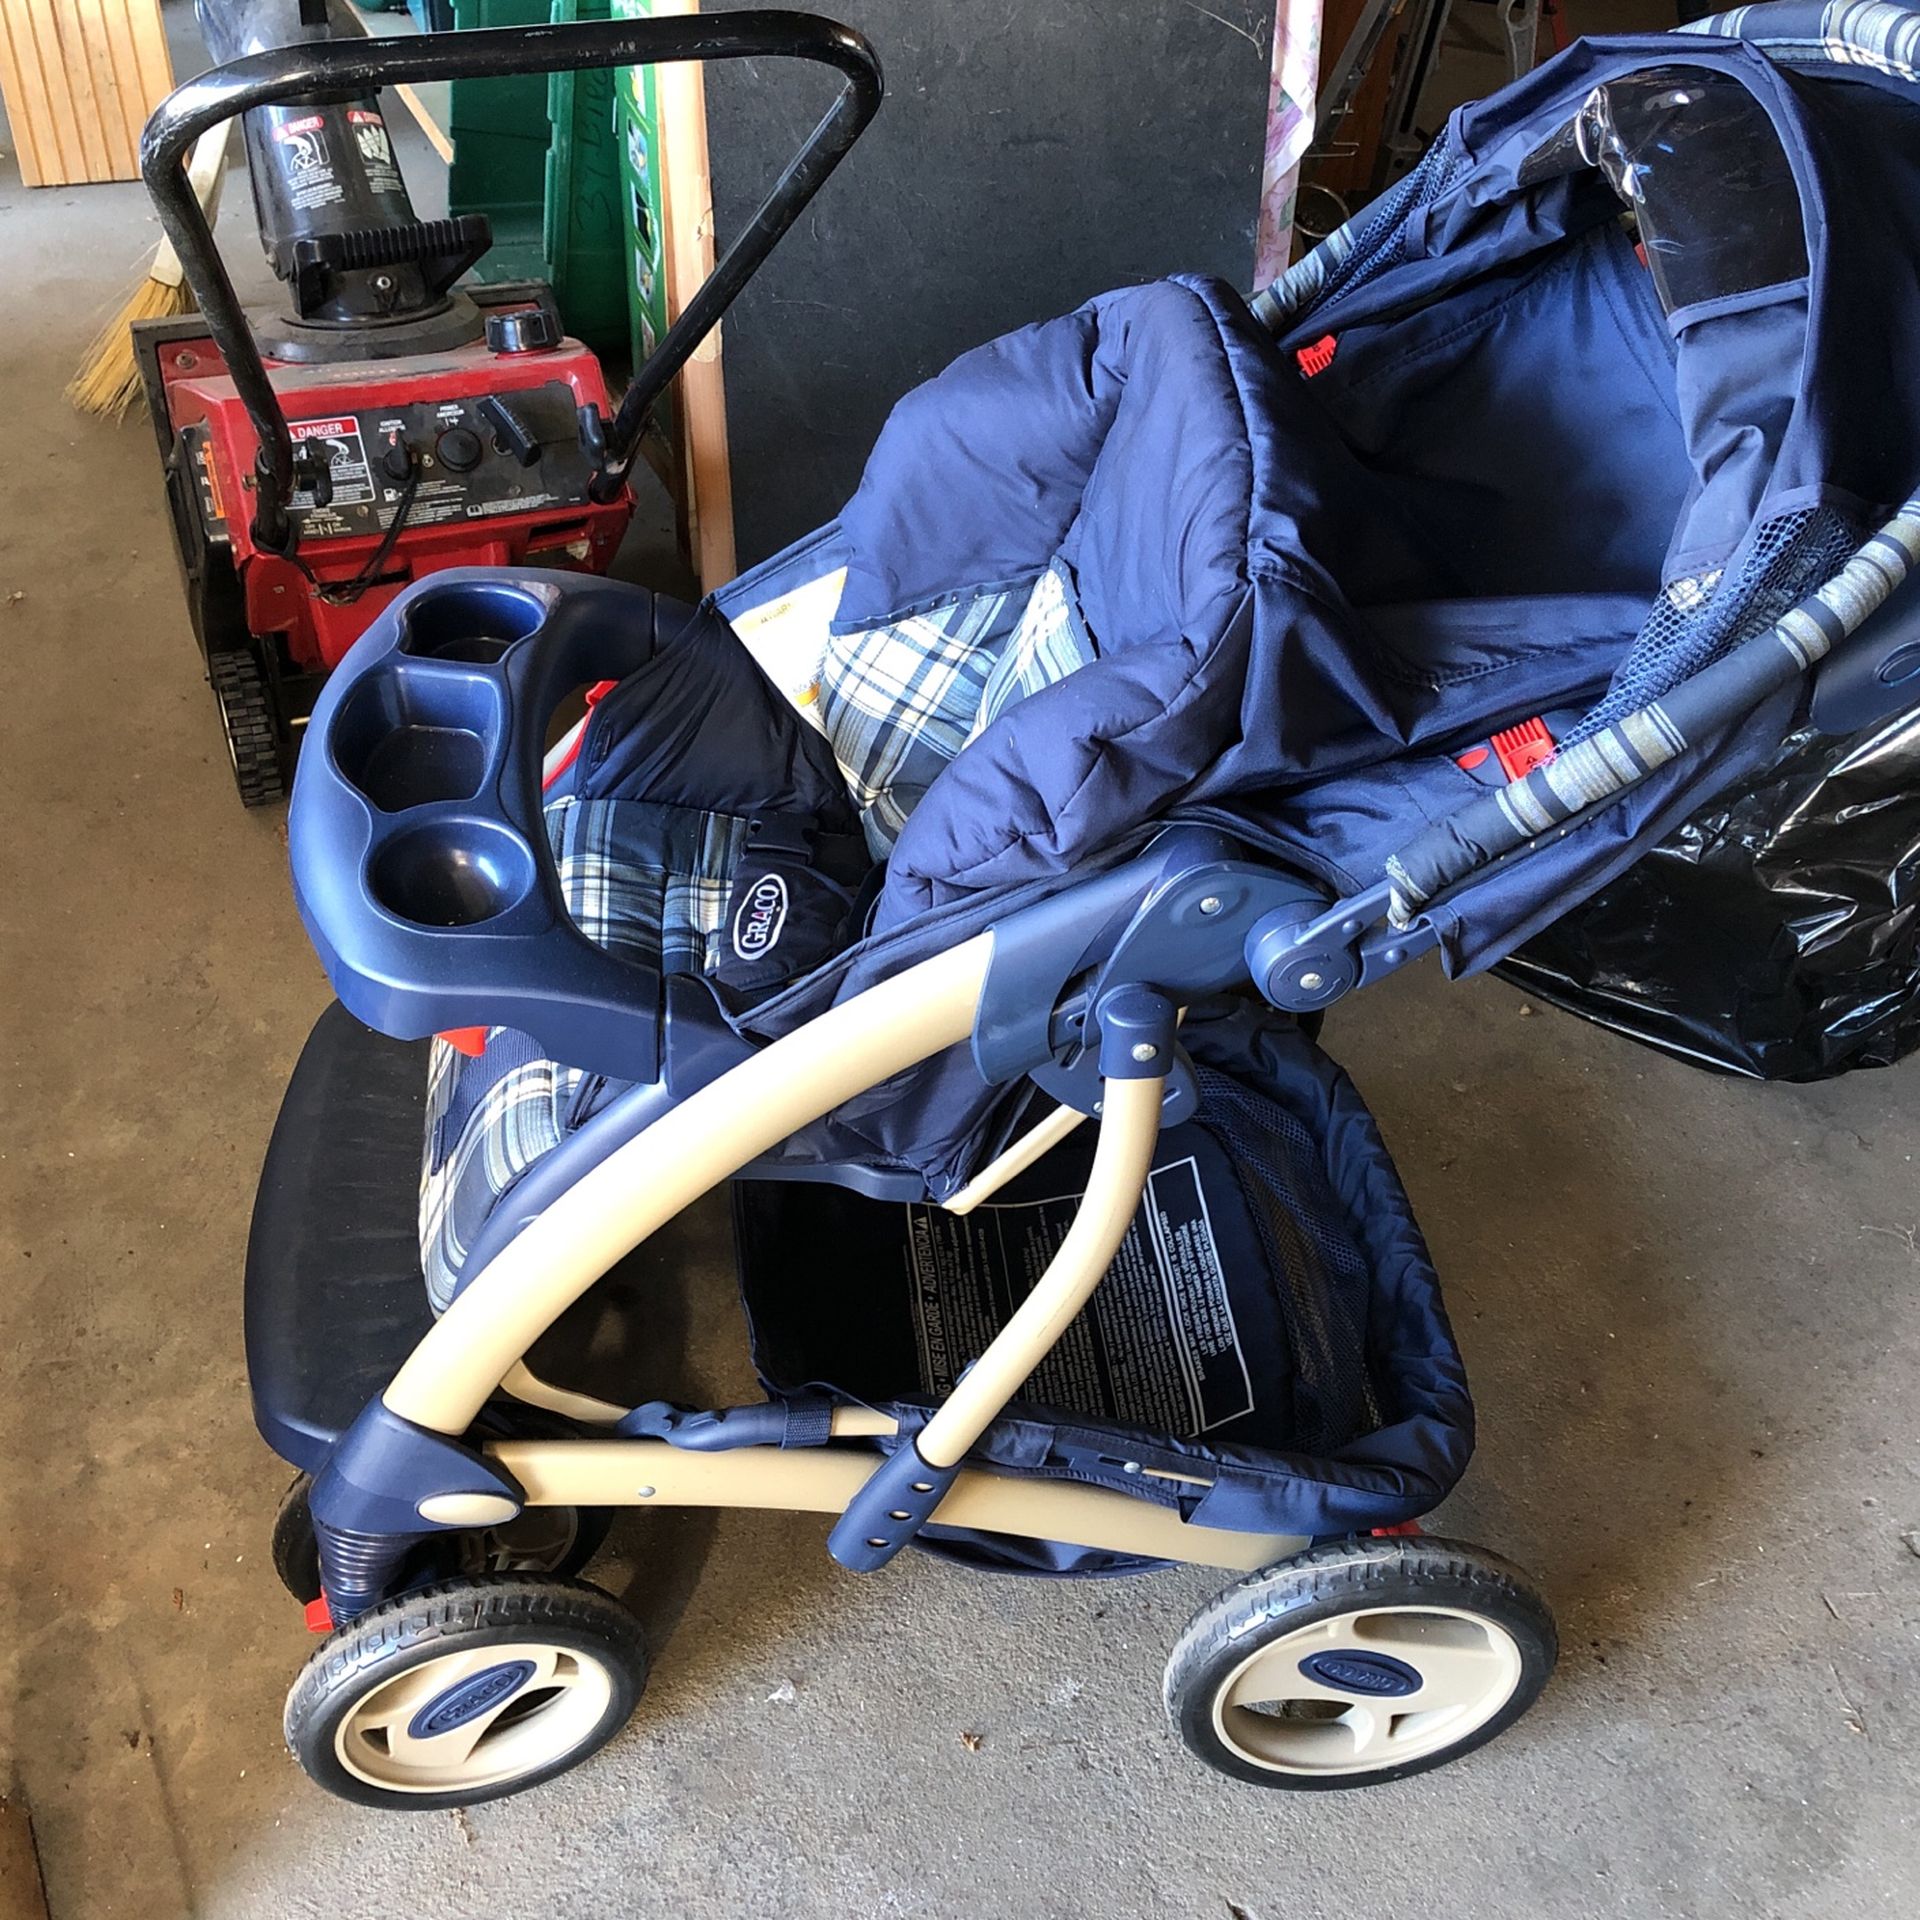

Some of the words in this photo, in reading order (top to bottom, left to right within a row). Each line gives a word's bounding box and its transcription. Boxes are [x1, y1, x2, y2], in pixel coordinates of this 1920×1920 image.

[297, 422, 344, 438] DANGER
[741, 884, 780, 949] GRACO
[1159, 1210, 1175, 1253] COLLAPSED
[913, 1227, 938, 1295] ADVERTENCIA
[923, 1299, 943, 1337] GARDE
[1182, 1310, 1193, 1330] LOCK
[929, 1334, 945, 1352] EN
